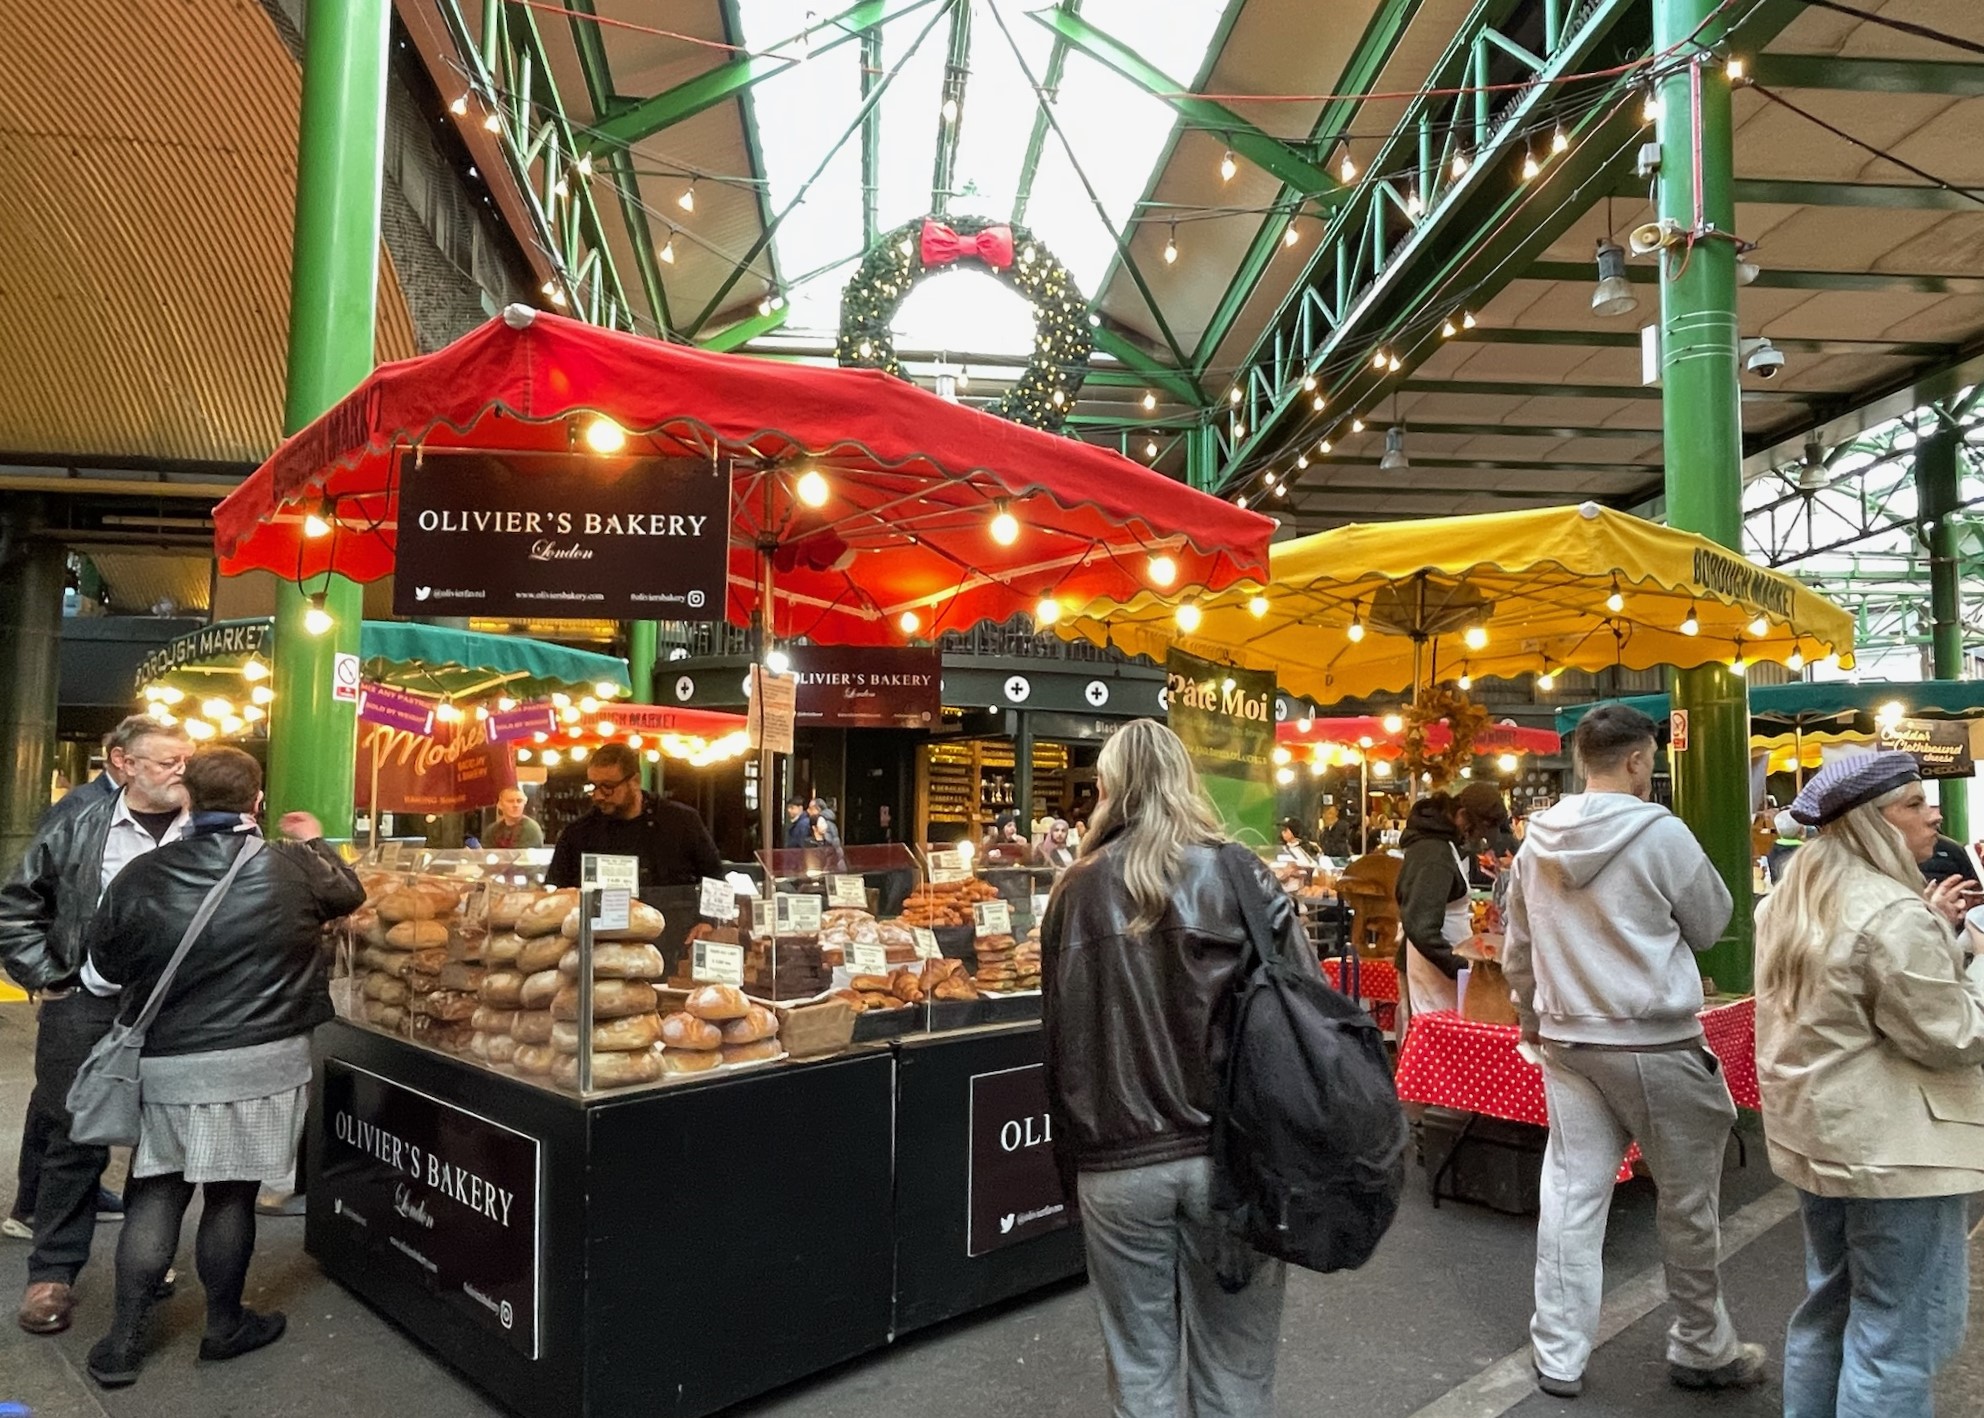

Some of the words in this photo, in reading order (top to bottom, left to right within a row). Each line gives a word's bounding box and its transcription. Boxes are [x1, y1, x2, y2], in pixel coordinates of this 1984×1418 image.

[418, 510, 572, 534] OLIVIER'S
[584, 513, 707, 537] BAKERY
[528, 538, 594, 561] London
[1693, 546, 1752, 602] BOROUGH
[1751, 569, 1796, 621] MARKET
[200, 624, 270, 655] MARKET
[800, 672, 866, 687] LIVIER'S
[870, 673, 932, 687] BAKERY
[1221, 686, 1268, 722] Moi
[1893, 738, 1964, 755] Clothbound
[335, 1109, 421, 1179] OLIVIER'S
[427, 1152, 514, 1227] BAKERY
